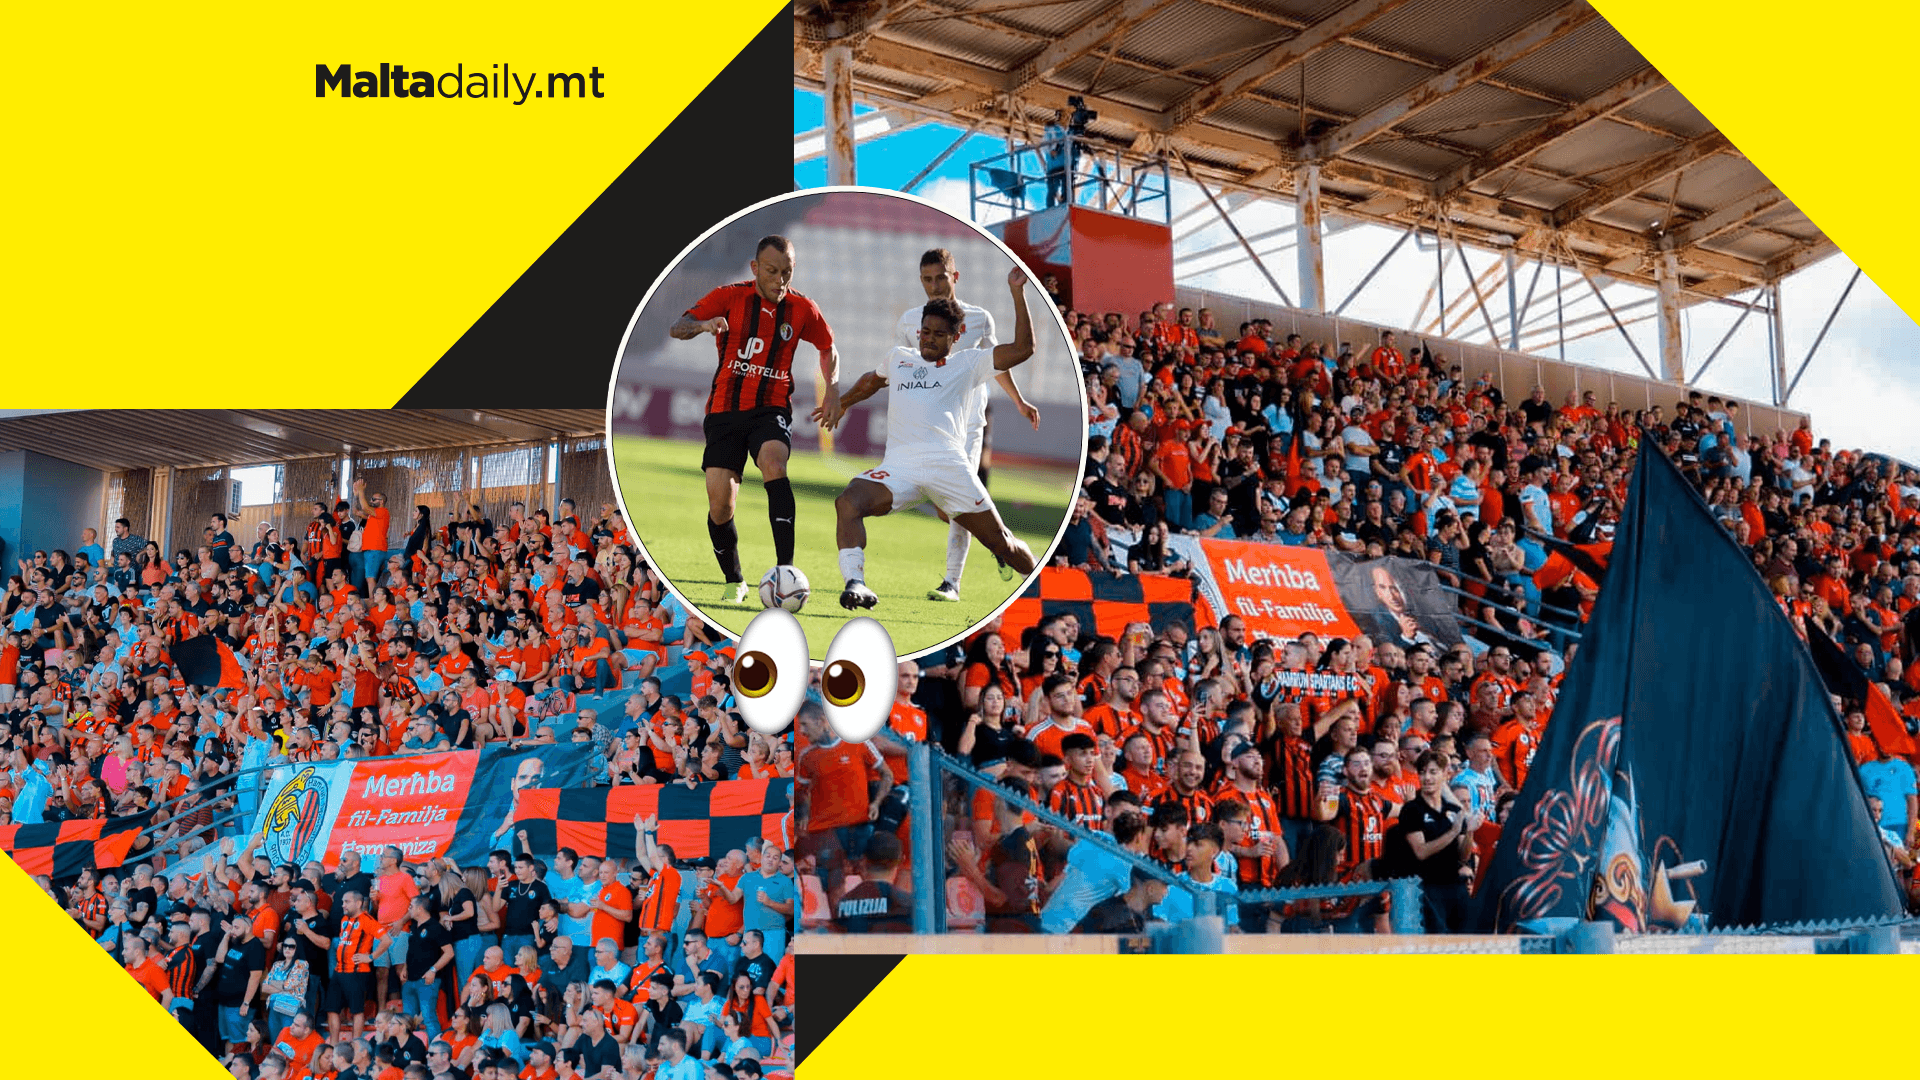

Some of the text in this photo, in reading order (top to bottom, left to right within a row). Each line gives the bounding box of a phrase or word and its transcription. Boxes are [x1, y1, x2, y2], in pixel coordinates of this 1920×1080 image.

[897, 381, 942, 391] INIALA
[1235, 596, 1339, 625] fil-Familja
[347, 805, 448, 827] fil-Familja
